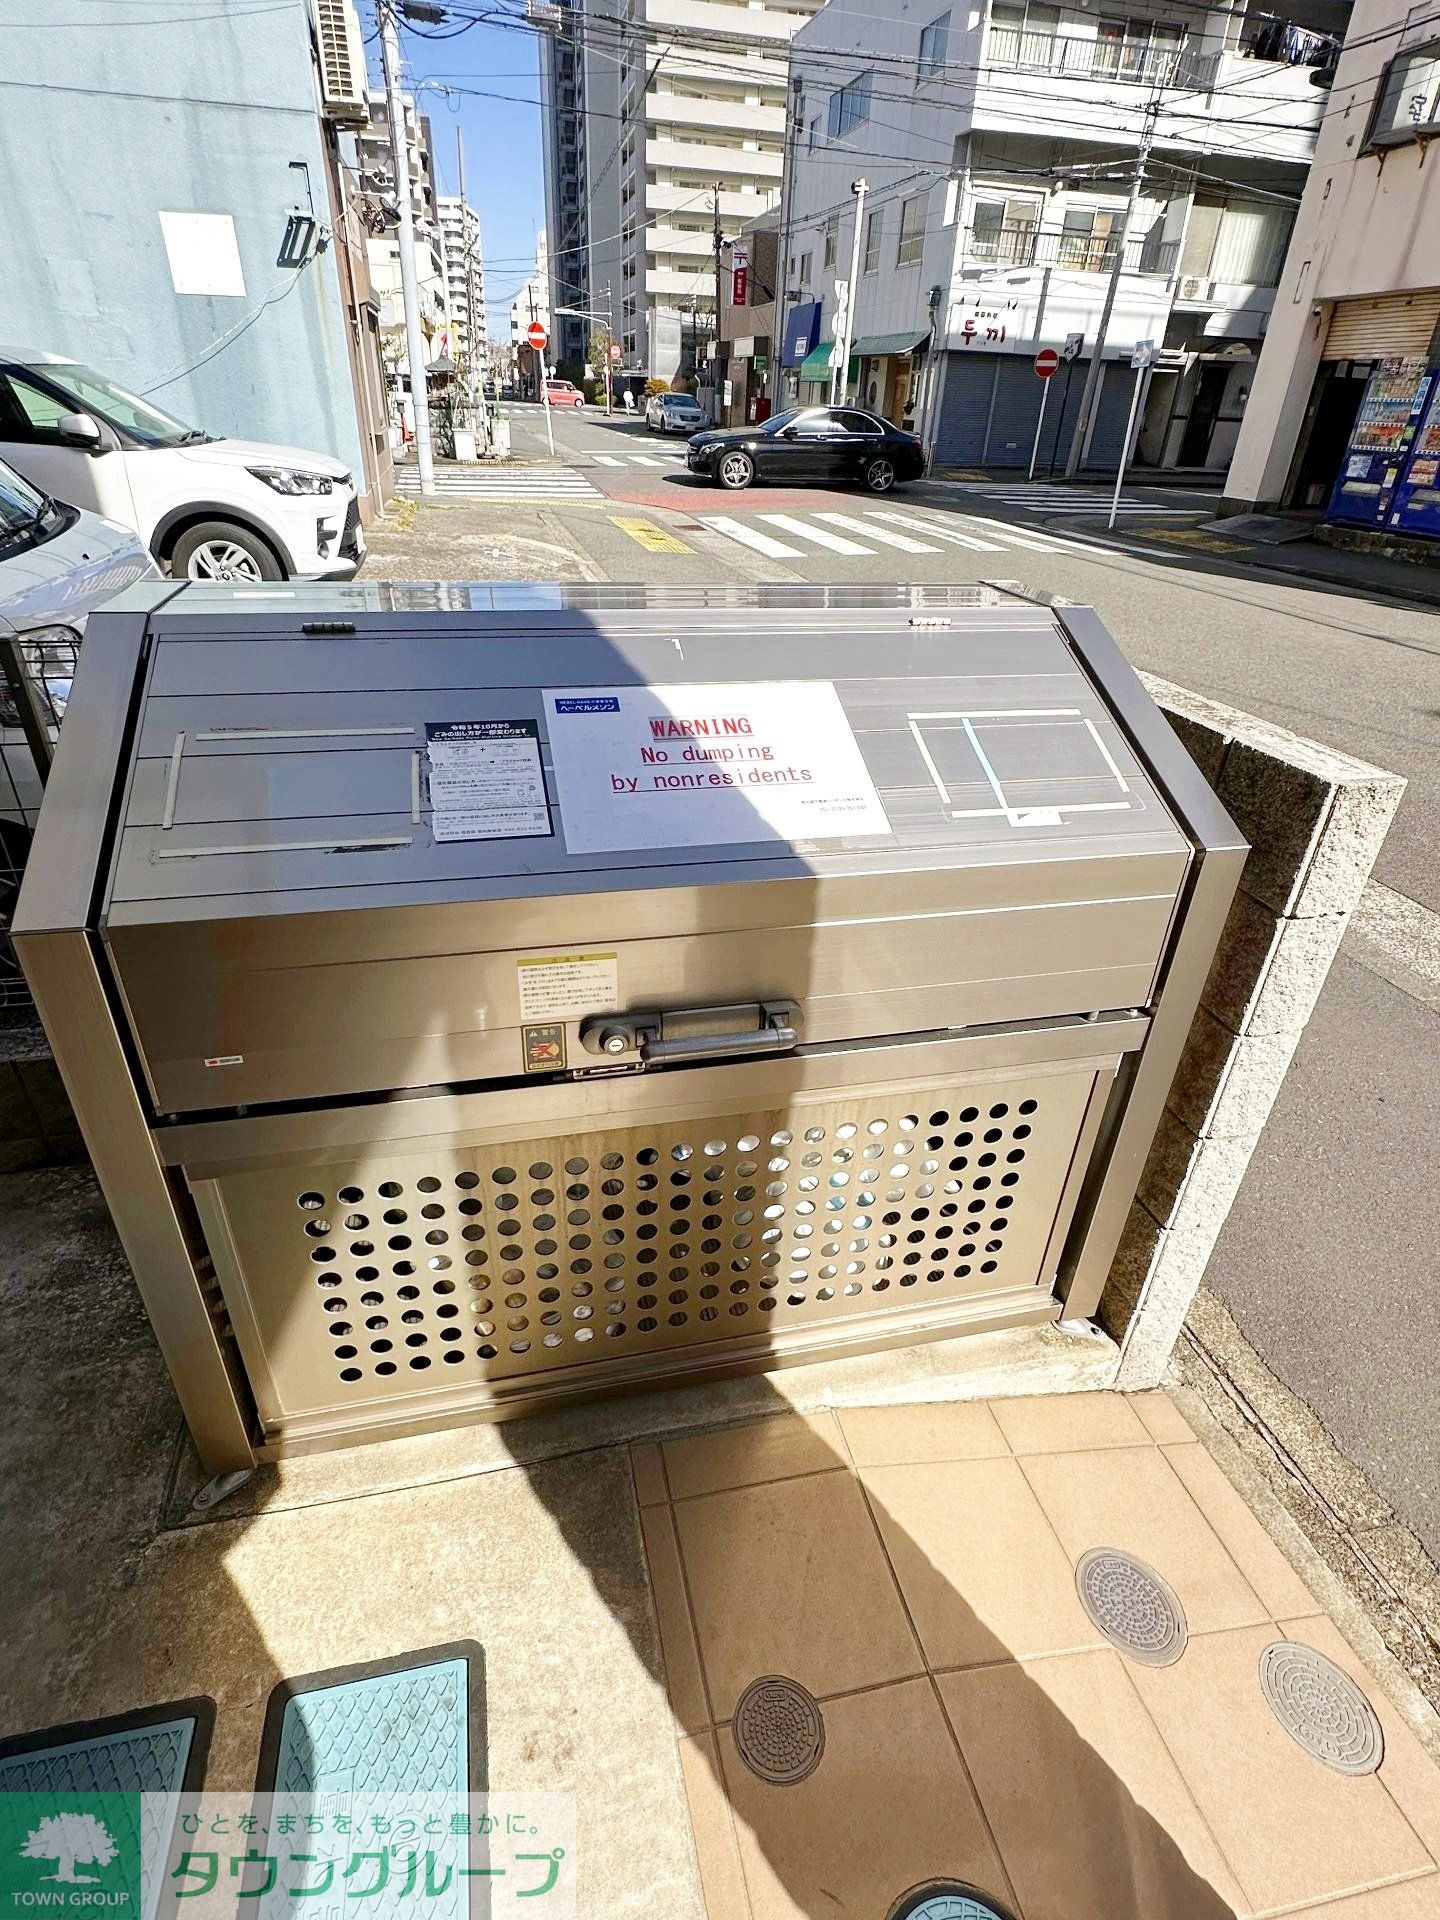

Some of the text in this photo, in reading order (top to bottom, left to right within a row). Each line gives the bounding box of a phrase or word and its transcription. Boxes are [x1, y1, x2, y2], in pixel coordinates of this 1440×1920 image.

[650, 717, 753, 737] WARNING
[640, 744, 774, 763] No dumping
[610, 767, 813, 793] by nonresidents
